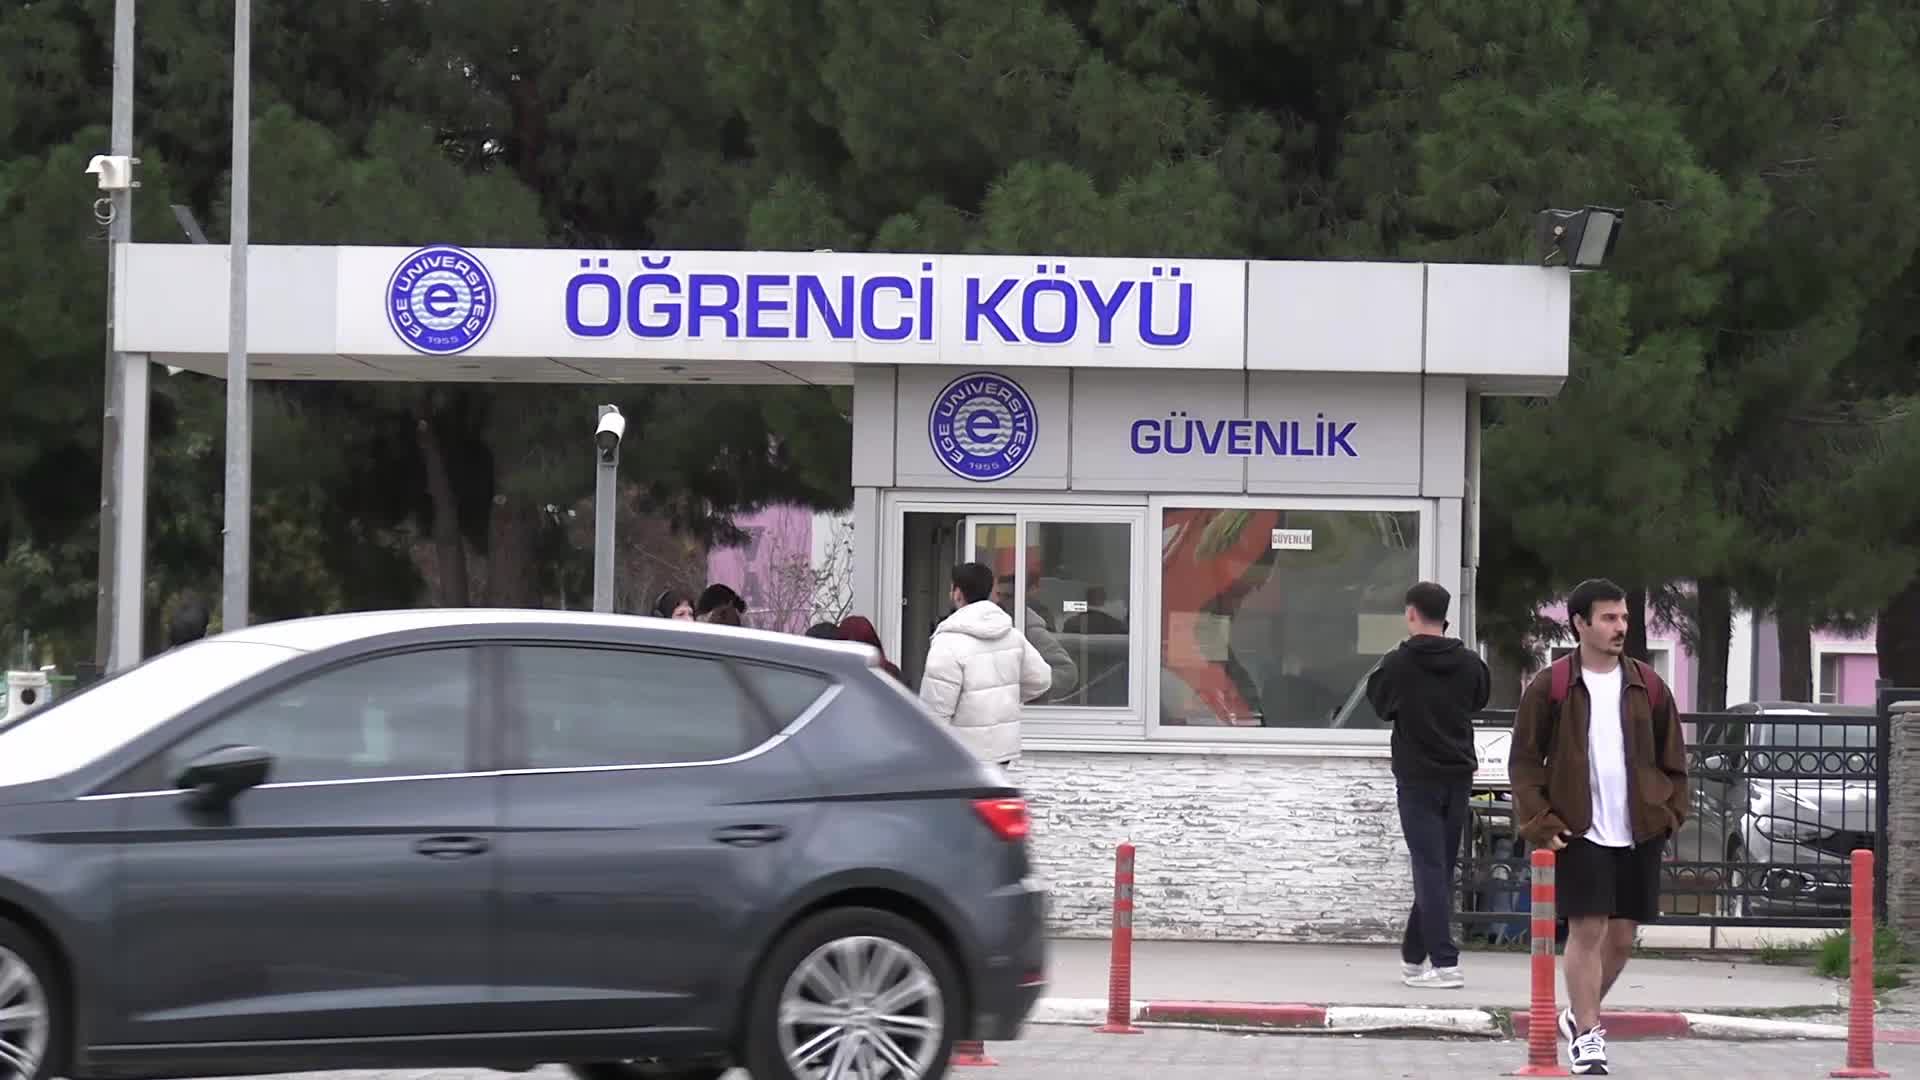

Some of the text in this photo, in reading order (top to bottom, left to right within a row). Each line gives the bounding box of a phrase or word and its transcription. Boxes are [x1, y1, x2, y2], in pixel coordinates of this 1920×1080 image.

[395, 297, 424, 339] EGE
[566, 255, 1193, 347] ÖĞRENCİ KÖYÜ
[938, 423, 965, 464] EGE
[1130, 411, 1358, 457] GÜVENLİK
